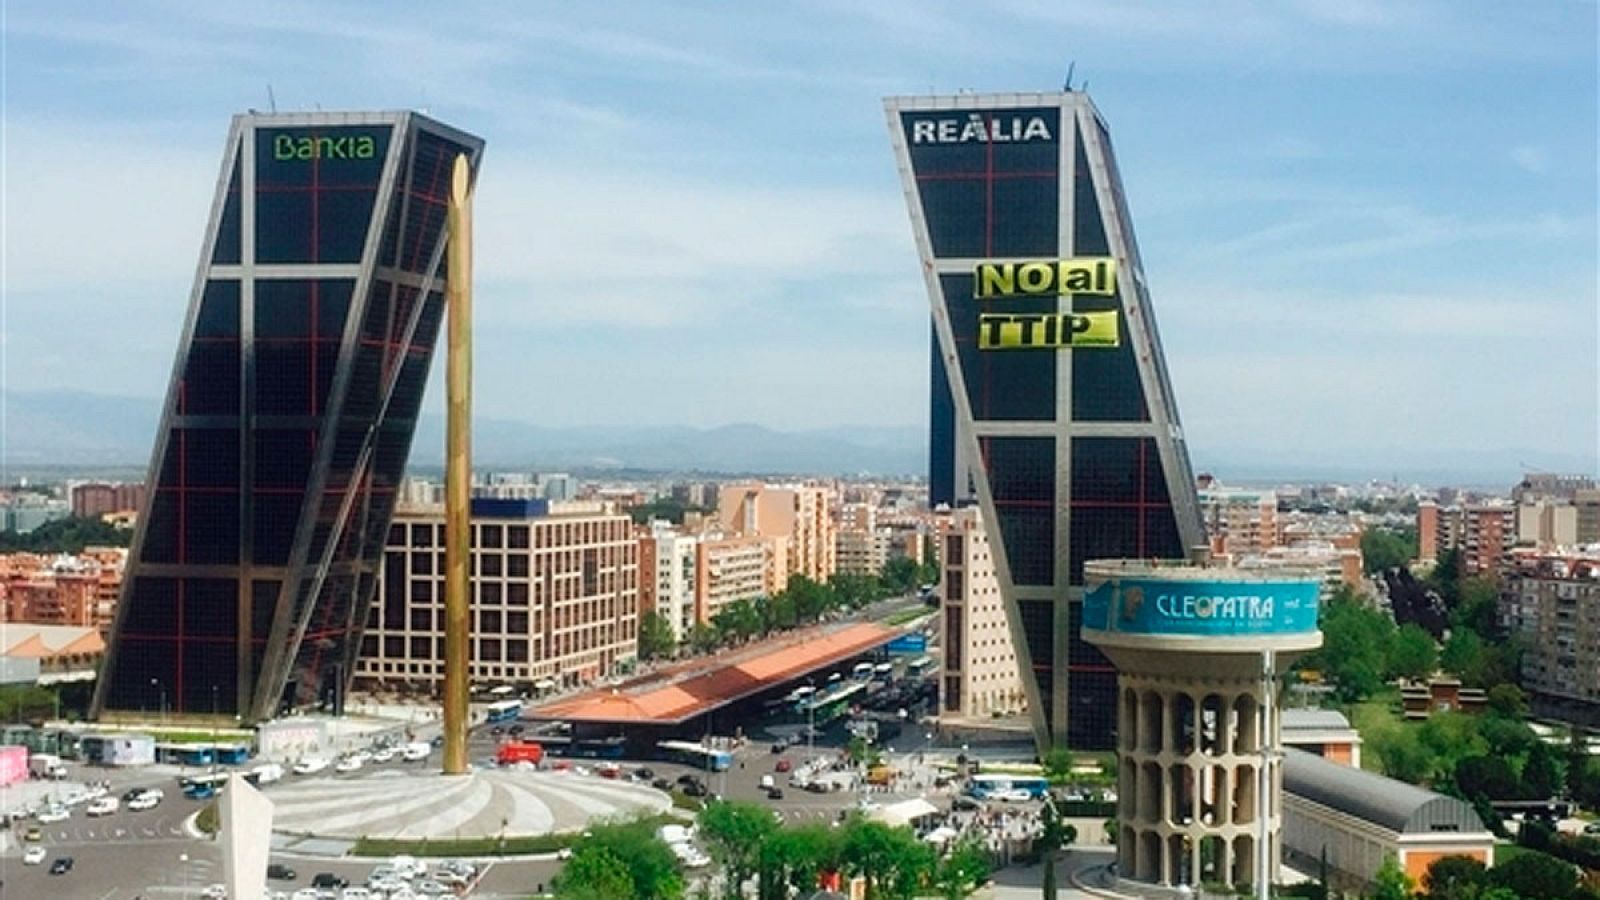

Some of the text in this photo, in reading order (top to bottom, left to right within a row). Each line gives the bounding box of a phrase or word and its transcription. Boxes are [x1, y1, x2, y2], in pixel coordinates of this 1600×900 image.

[912, 117, 1051, 143] REALIA
[276, 134, 374, 159] Bankia
[982, 262, 1107, 295] NO al
[982, 315, 1090, 345] TTIP
[1156, 596, 1273, 619] CLEOPATRA
